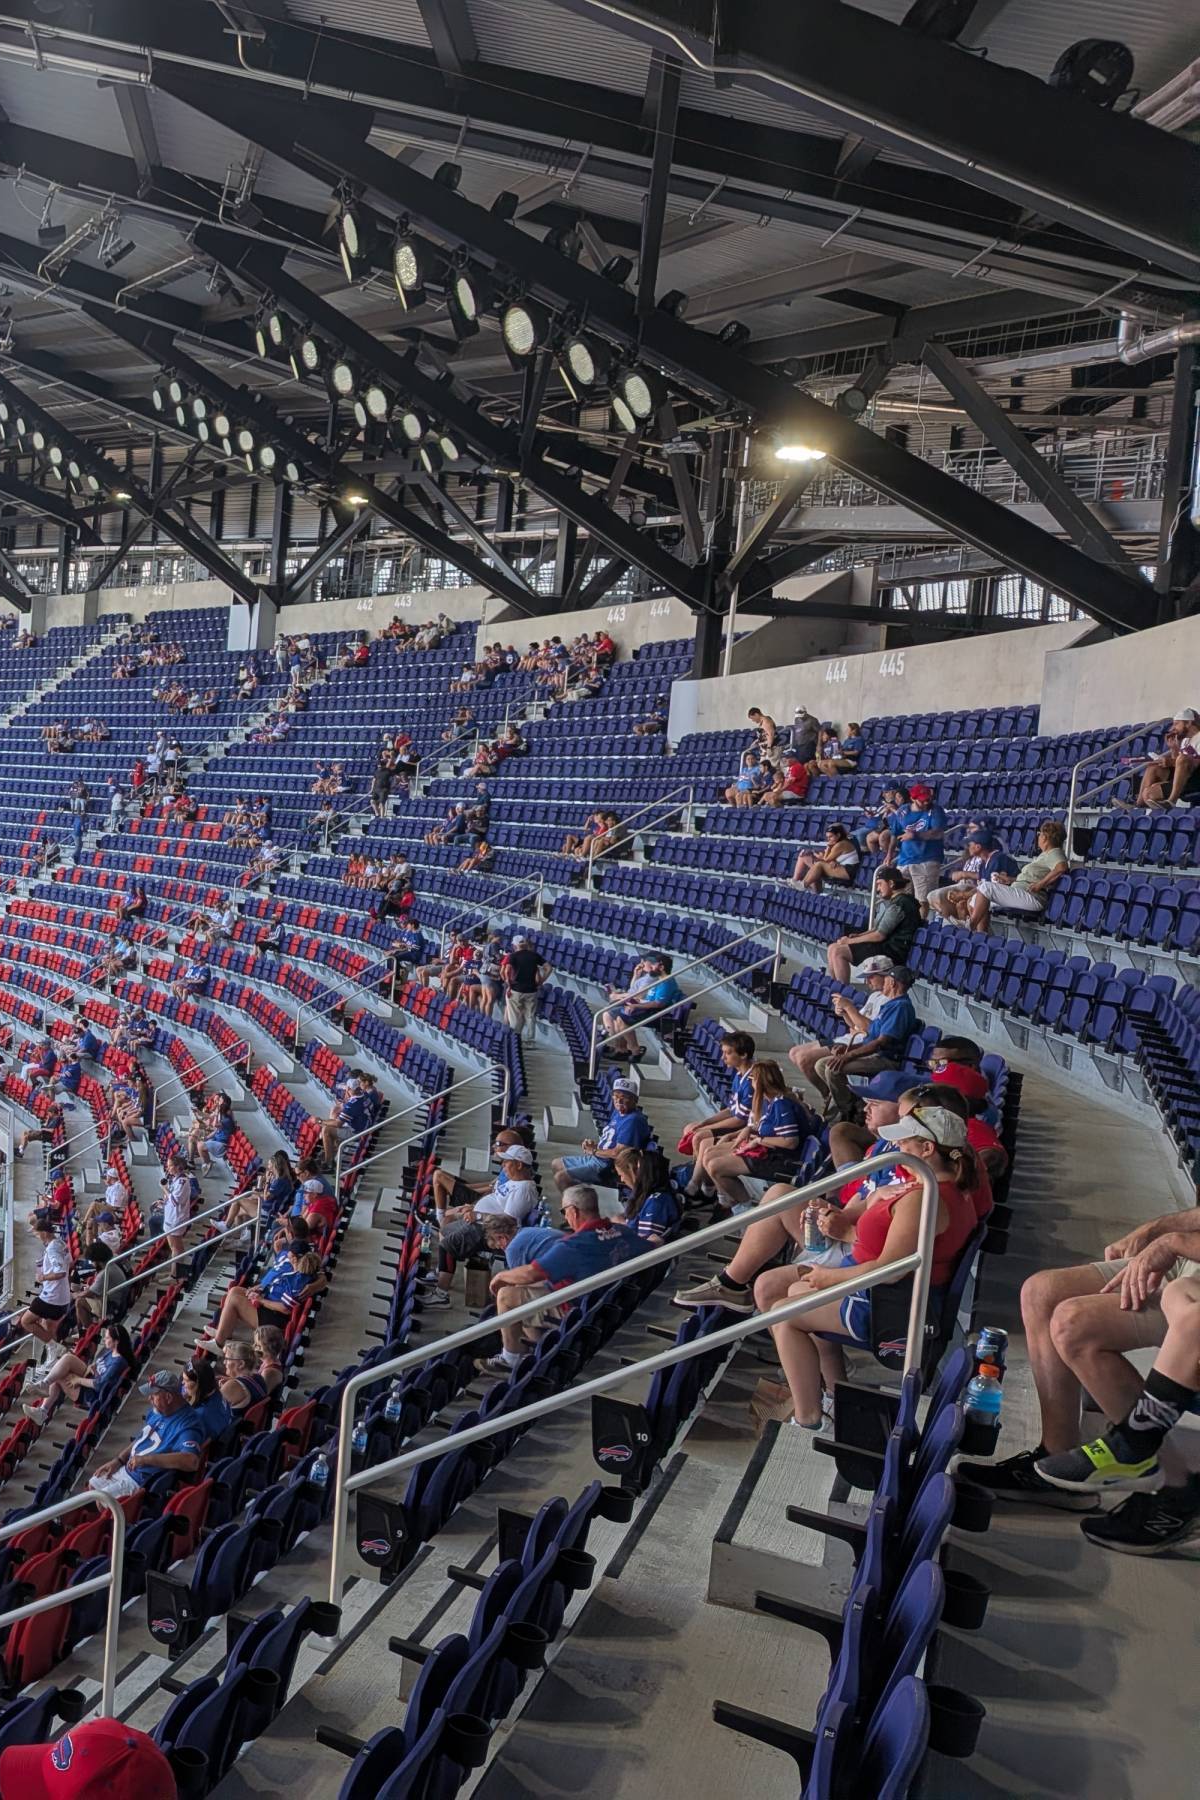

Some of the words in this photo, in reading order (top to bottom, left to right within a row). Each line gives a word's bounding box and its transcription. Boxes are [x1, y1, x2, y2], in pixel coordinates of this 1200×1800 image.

[153, 586, 167, 595] 442
[357, 600, 373, 611] 442
[394, 596, 412, 608] 443
[650, 600, 670, 617] 444
[607, 607, 626, 623] 443
[880, 652, 905, 677] 445
[825, 661, 848, 684] 444
[924, 1324, 934, 1334] 11
[130, 1425, 161, 1457] 17
[636, 1433, 648, 1442] 10
[396, 1529, 403, 1538] 9
